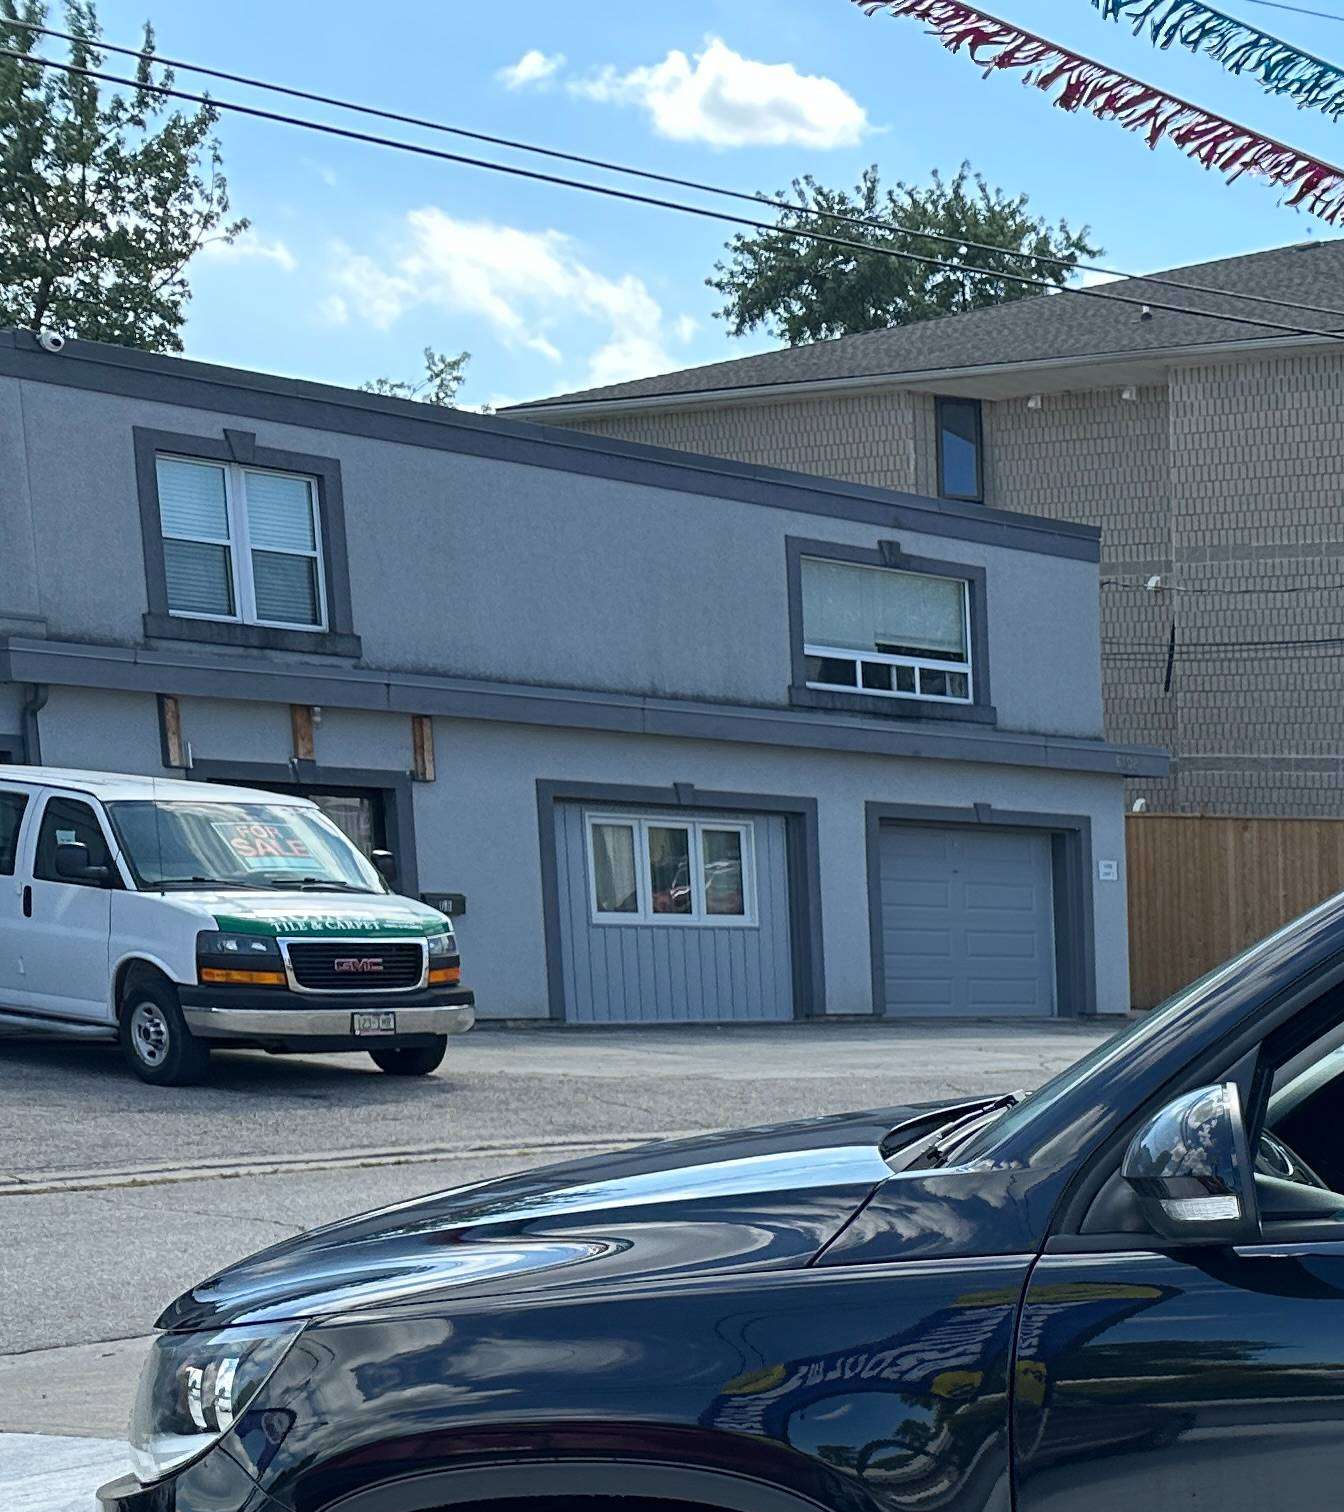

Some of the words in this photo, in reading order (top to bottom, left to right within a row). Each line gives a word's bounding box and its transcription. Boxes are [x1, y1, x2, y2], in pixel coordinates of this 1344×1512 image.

[235, 825, 284, 839] FOR
[231, 838, 312, 857] SALE
[271, 920, 308, 932] TILE
[325, 919, 381, 930] CARPET
[334, 958, 384, 971] GMC
